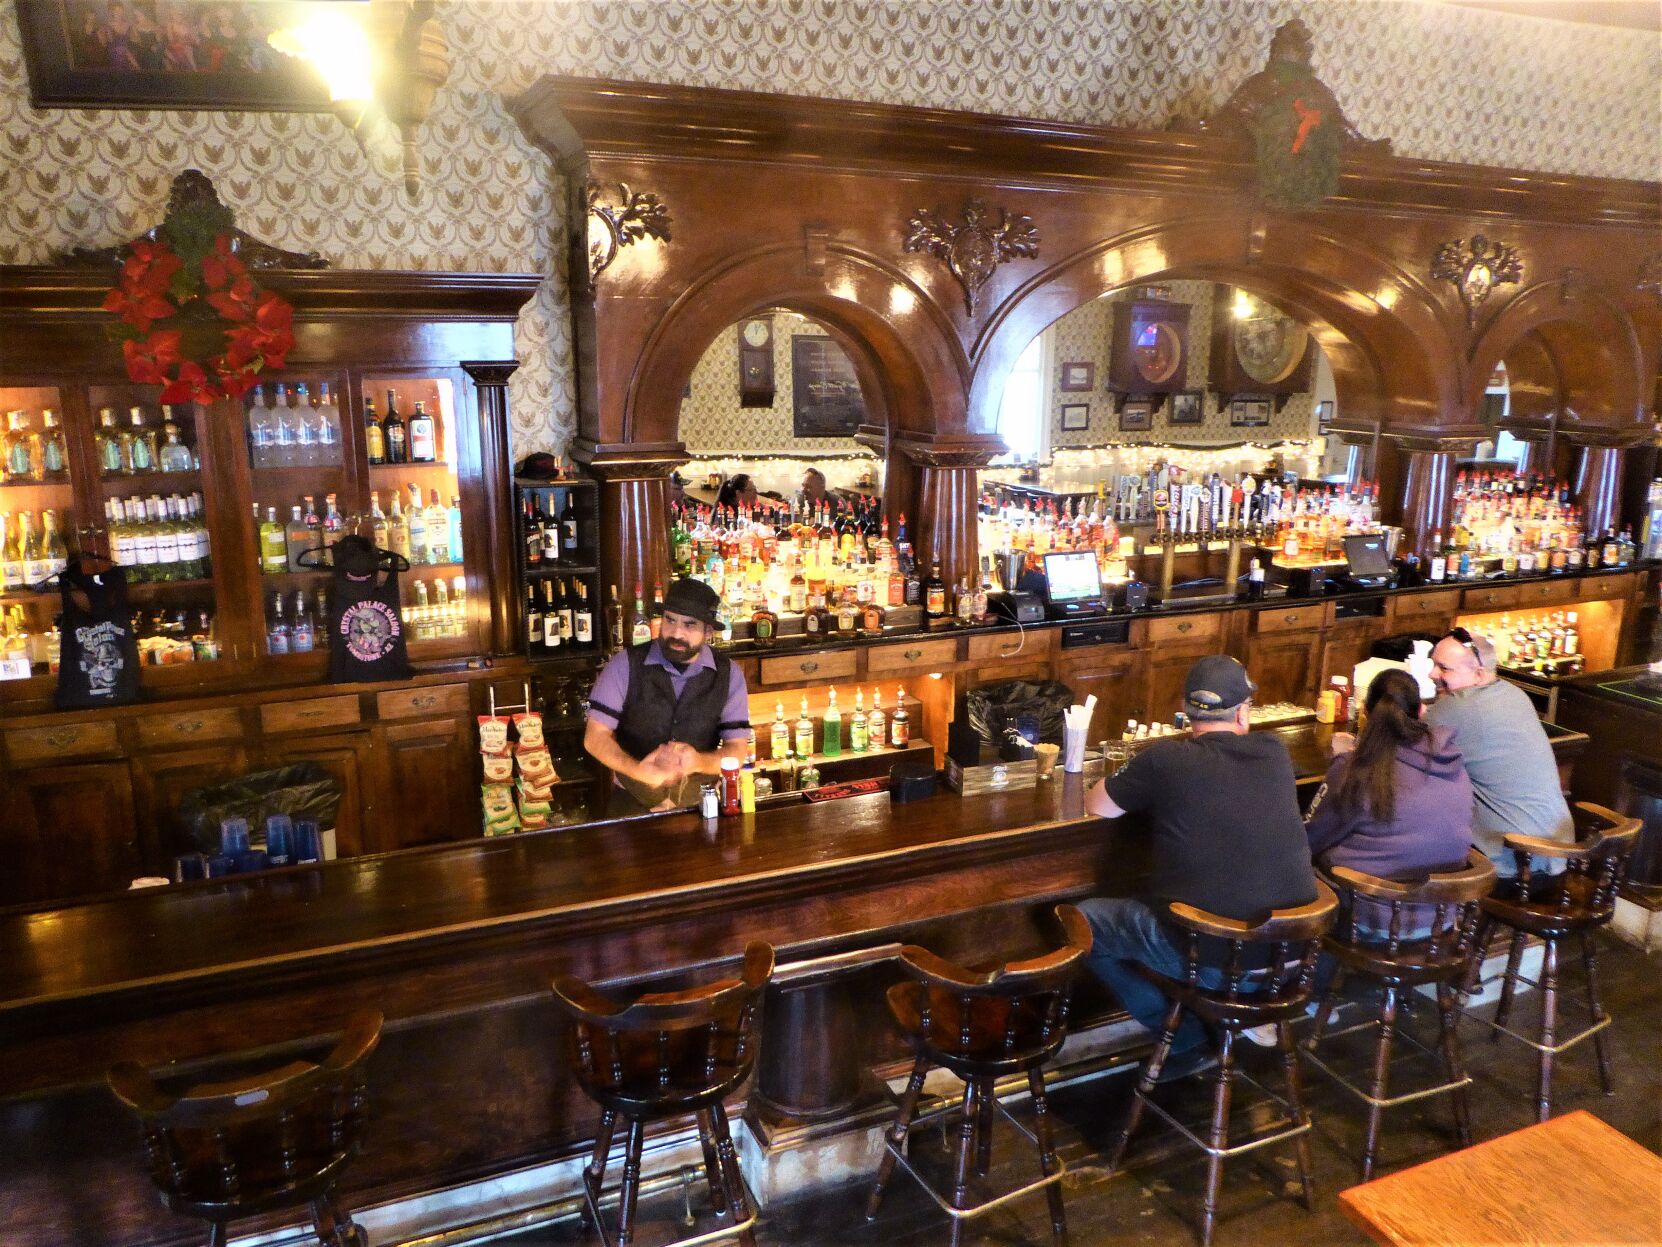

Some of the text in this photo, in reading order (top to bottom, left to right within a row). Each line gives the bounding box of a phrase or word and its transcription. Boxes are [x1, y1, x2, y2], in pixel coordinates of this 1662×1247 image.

[340, 600, 401, 637] CRYSTAL PALACE SALOON
